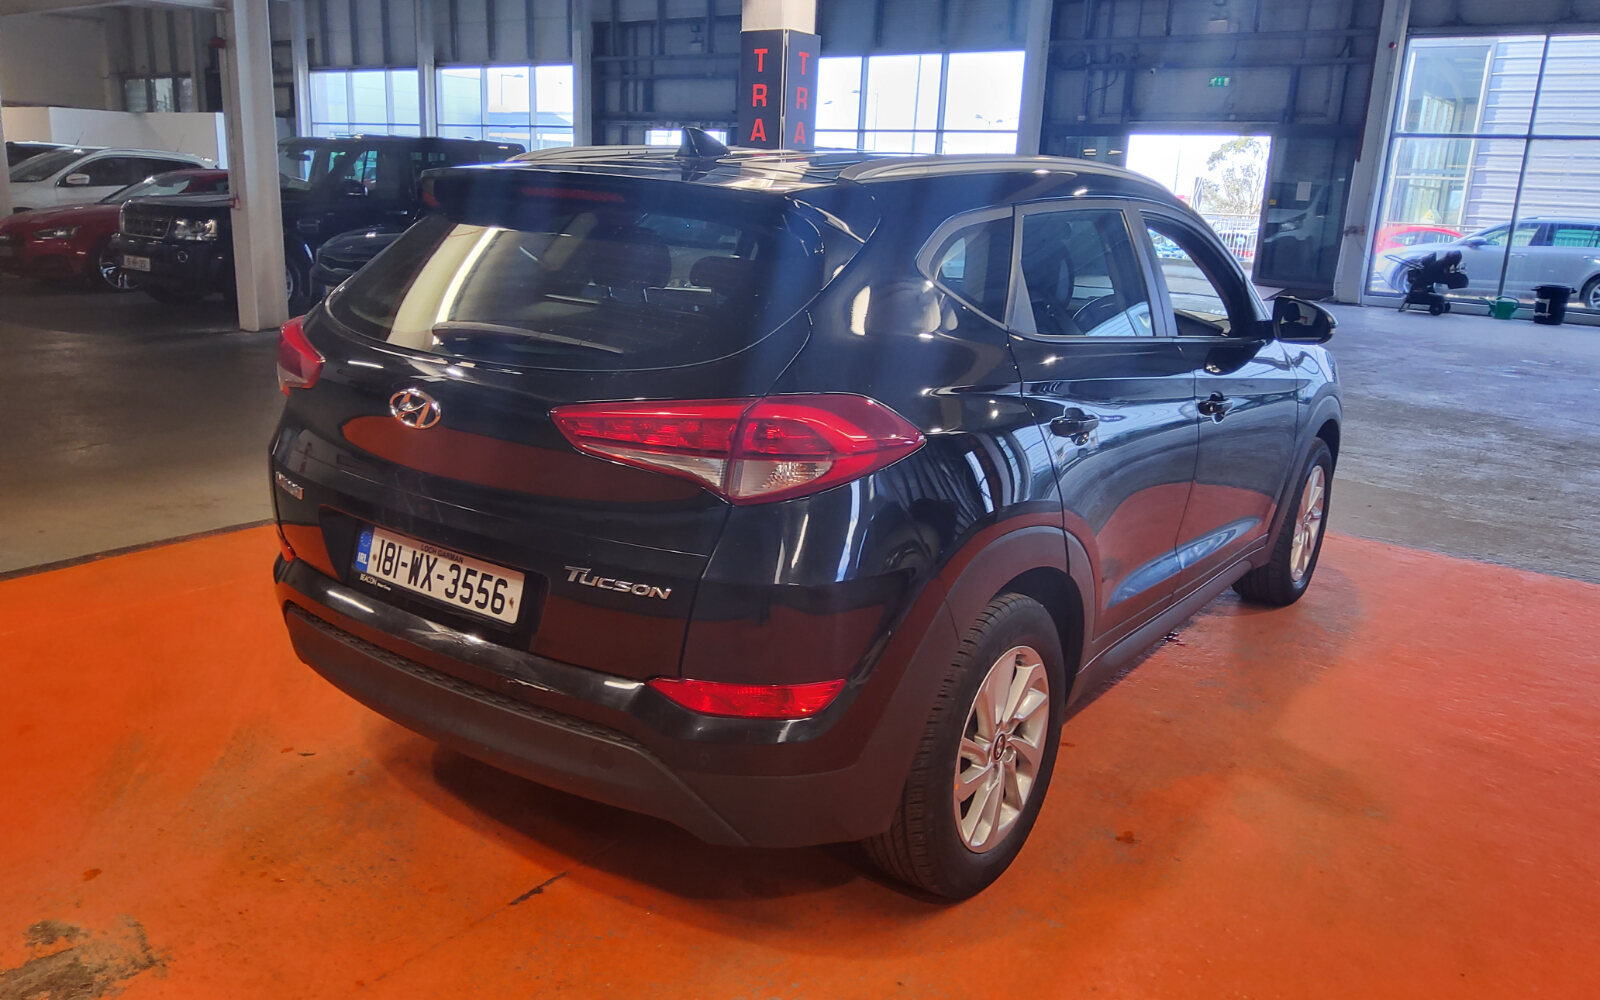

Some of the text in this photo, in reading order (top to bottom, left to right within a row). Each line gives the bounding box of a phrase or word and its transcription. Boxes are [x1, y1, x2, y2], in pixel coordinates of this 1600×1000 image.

[357, 551, 368, 565] IRL
[376, 539, 508, 615] 181-WX-3556
[564, 565, 672, 600] TUCSON
